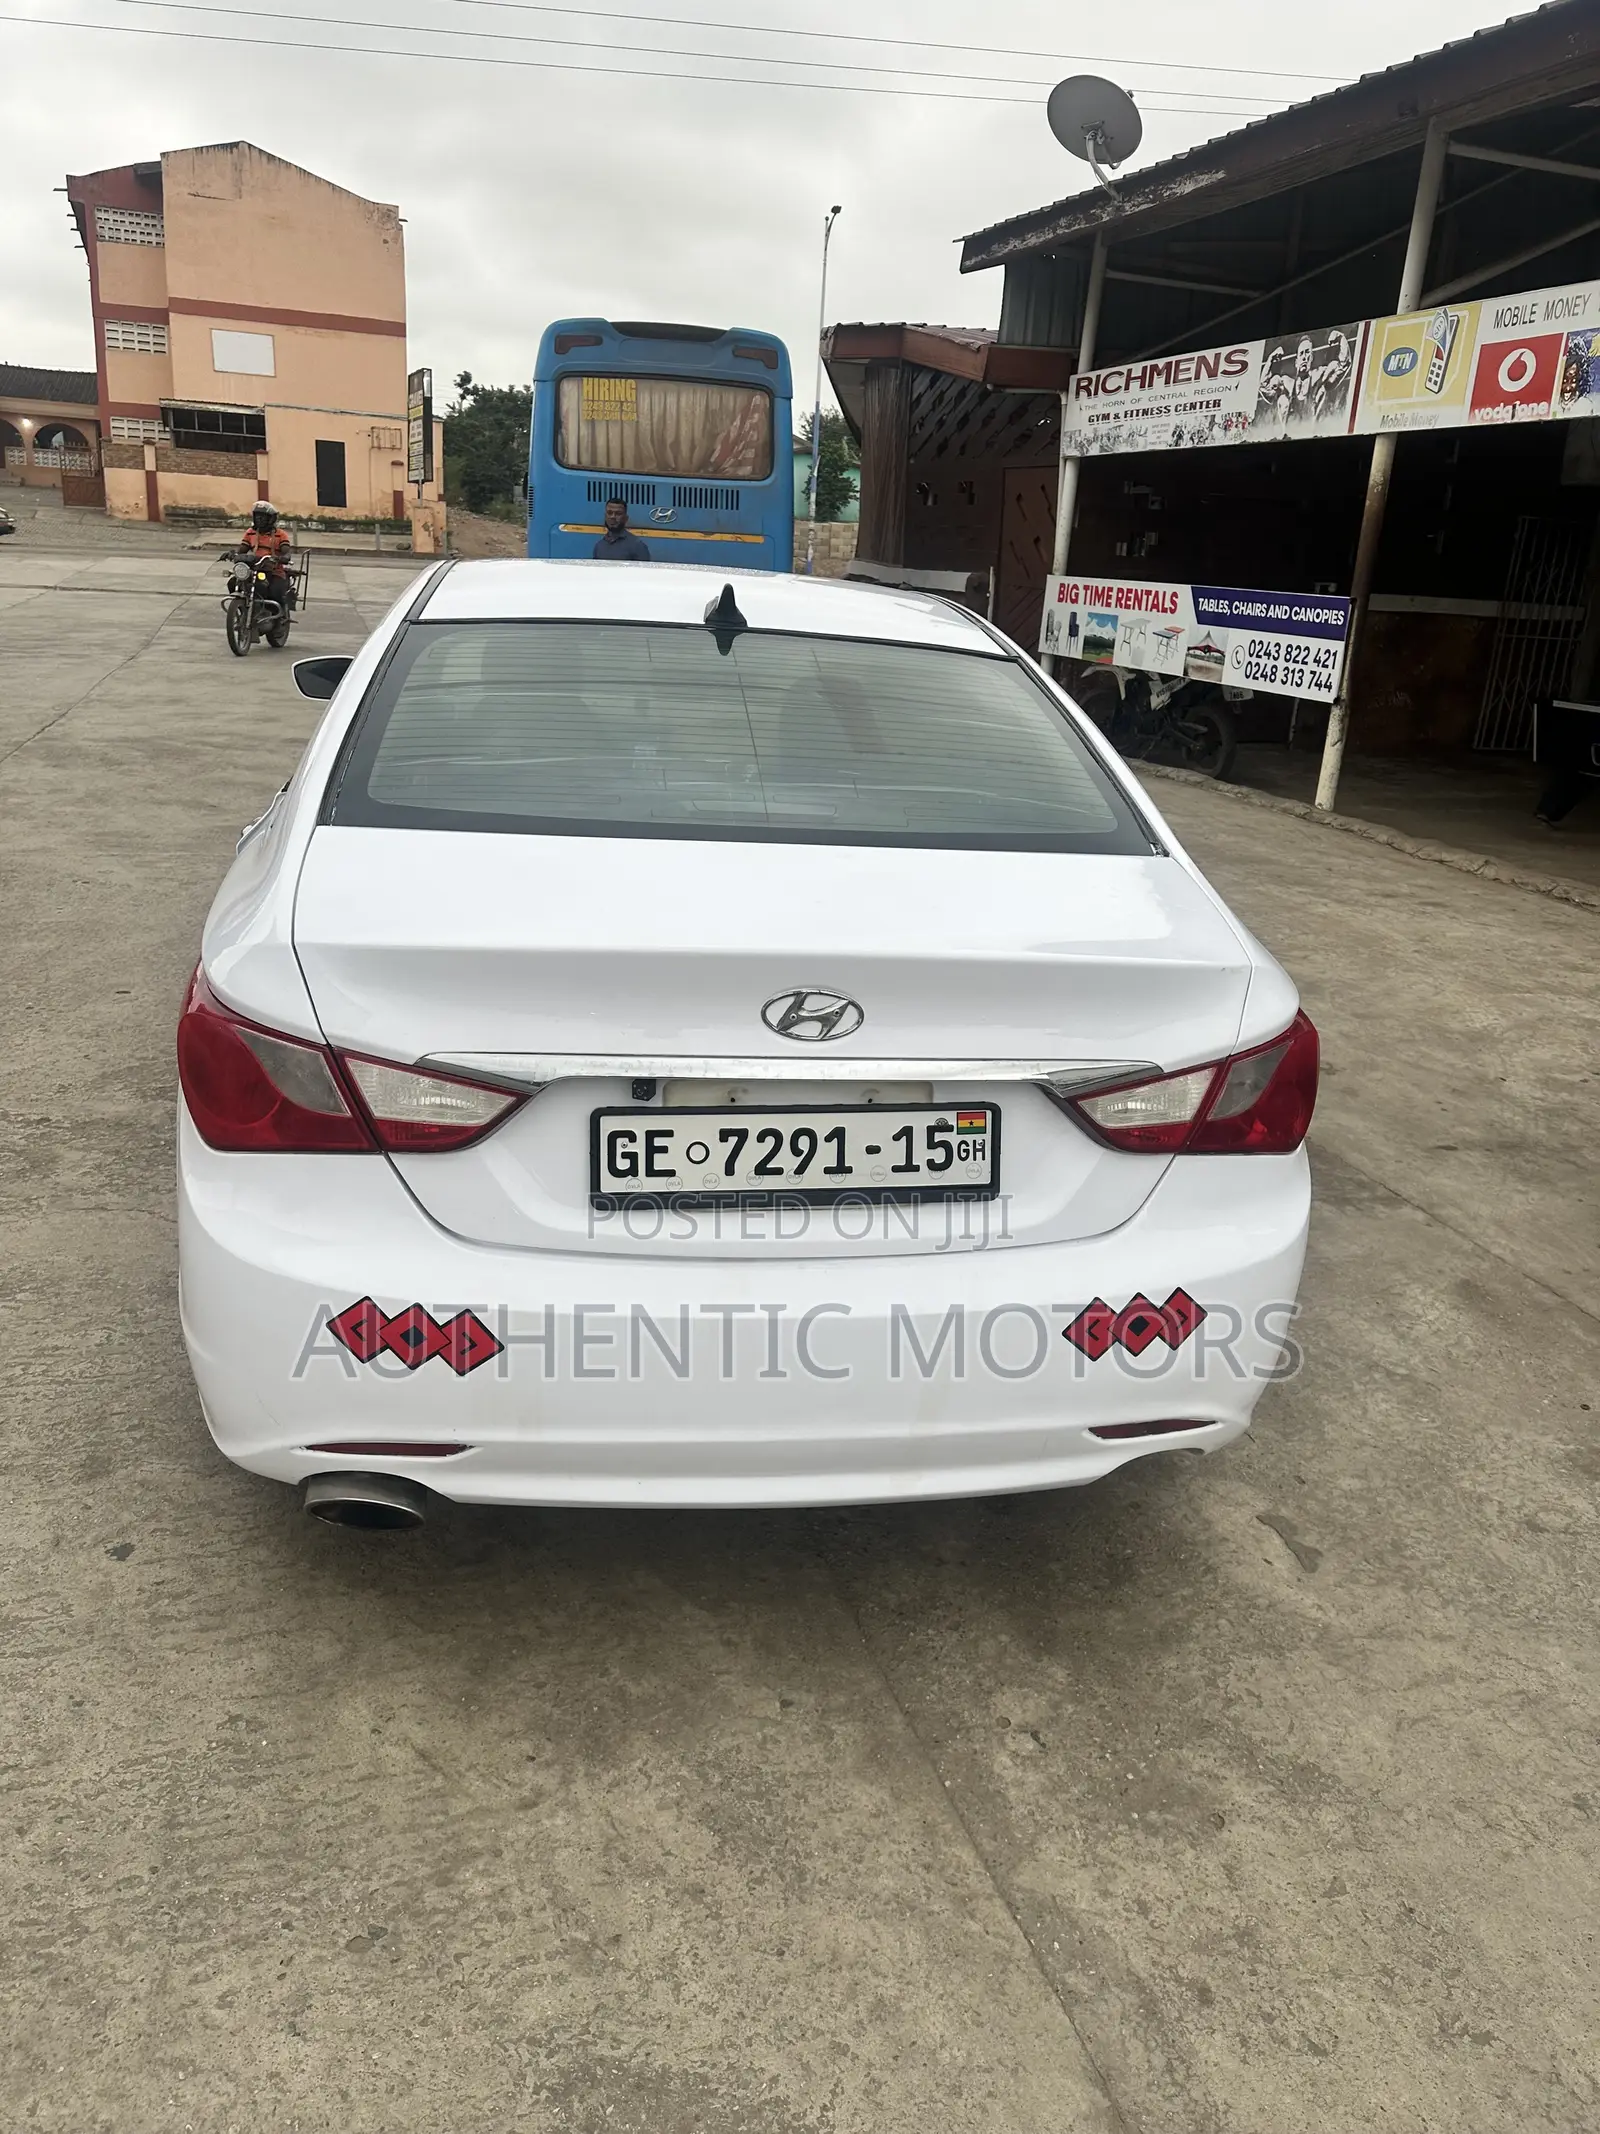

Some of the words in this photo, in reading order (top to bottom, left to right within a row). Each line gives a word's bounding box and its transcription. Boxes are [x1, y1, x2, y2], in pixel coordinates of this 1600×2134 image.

[1493, 303, 1538, 329] MOBILE
[1543, 293, 1591, 322] MONEY
[1075, 349, 1249, 400] RICHMENS
[1387, 352, 1412, 371] MTN
[583, 378, 637, 401] HIRING
[1102, 399, 1126, 408] HORN
[1130, 396, 1143, 405] OF
[1148, 391, 1188, 402] CENTRAL
[1193, 385, 1232, 396] REGION
[1088, 412, 1111, 424] GYM
[1113, 412, 1122, 422] &
[1123, 405, 1171, 420] FITNESS
[1174, 398, 1222, 413] CENTER
[1380, 412, 1409, 428] Mobile
[1411, 412, 1439, 428] Money
[1057, 583, 1079, 604] BIG
[1083, 585, 1113, 608] TIME
[1115, 587, 1179, 614] RENTALS
[1198, 598, 1230, 616] TABLES,
[1232, 601, 1267, 618] CHAIRS
[1267, 604, 1290, 619] AND
[1291, 607, 1345, 625] CANOPIES
[1248, 639, 1282, 661] 0243
[1284, 643, 1310, 665] 822
[1313, 648, 1338, 670] 421
[1245, 661, 1278, 683] 0248
[1281, 666, 1305, 688] 313
[1308, 670, 1333, 693] 744
[607, 1128, 676, 1178] GE
[957, 1139, 986, 1162] GH
